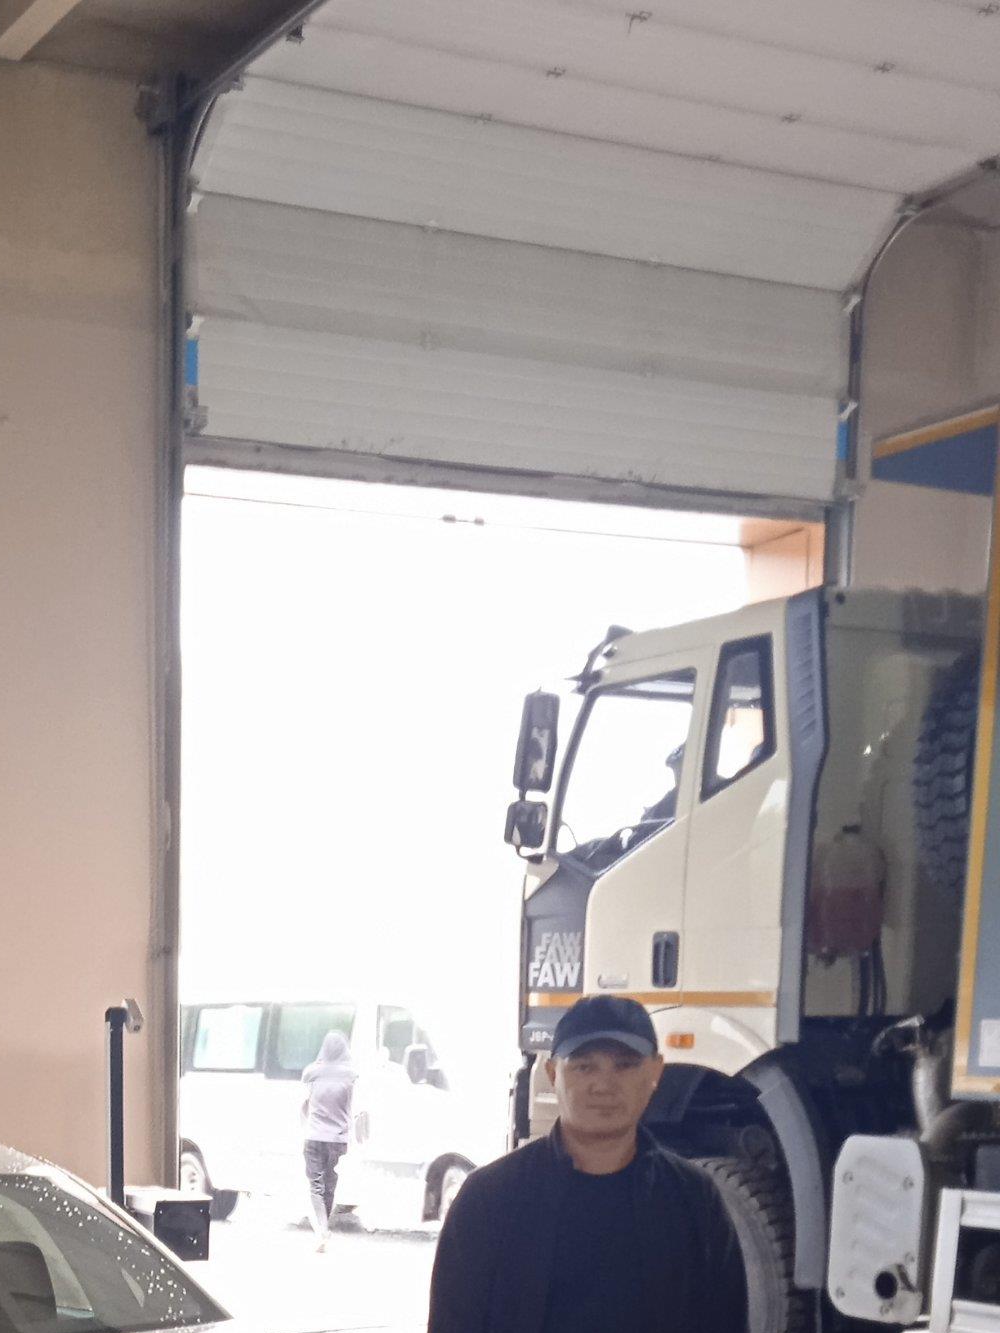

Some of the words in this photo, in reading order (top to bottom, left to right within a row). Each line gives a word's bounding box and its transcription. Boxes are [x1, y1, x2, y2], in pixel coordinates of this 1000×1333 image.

[540, 931, 581, 949] FAW
[534, 945, 581, 964] FAW
[528, 961, 581, 987] FAW
